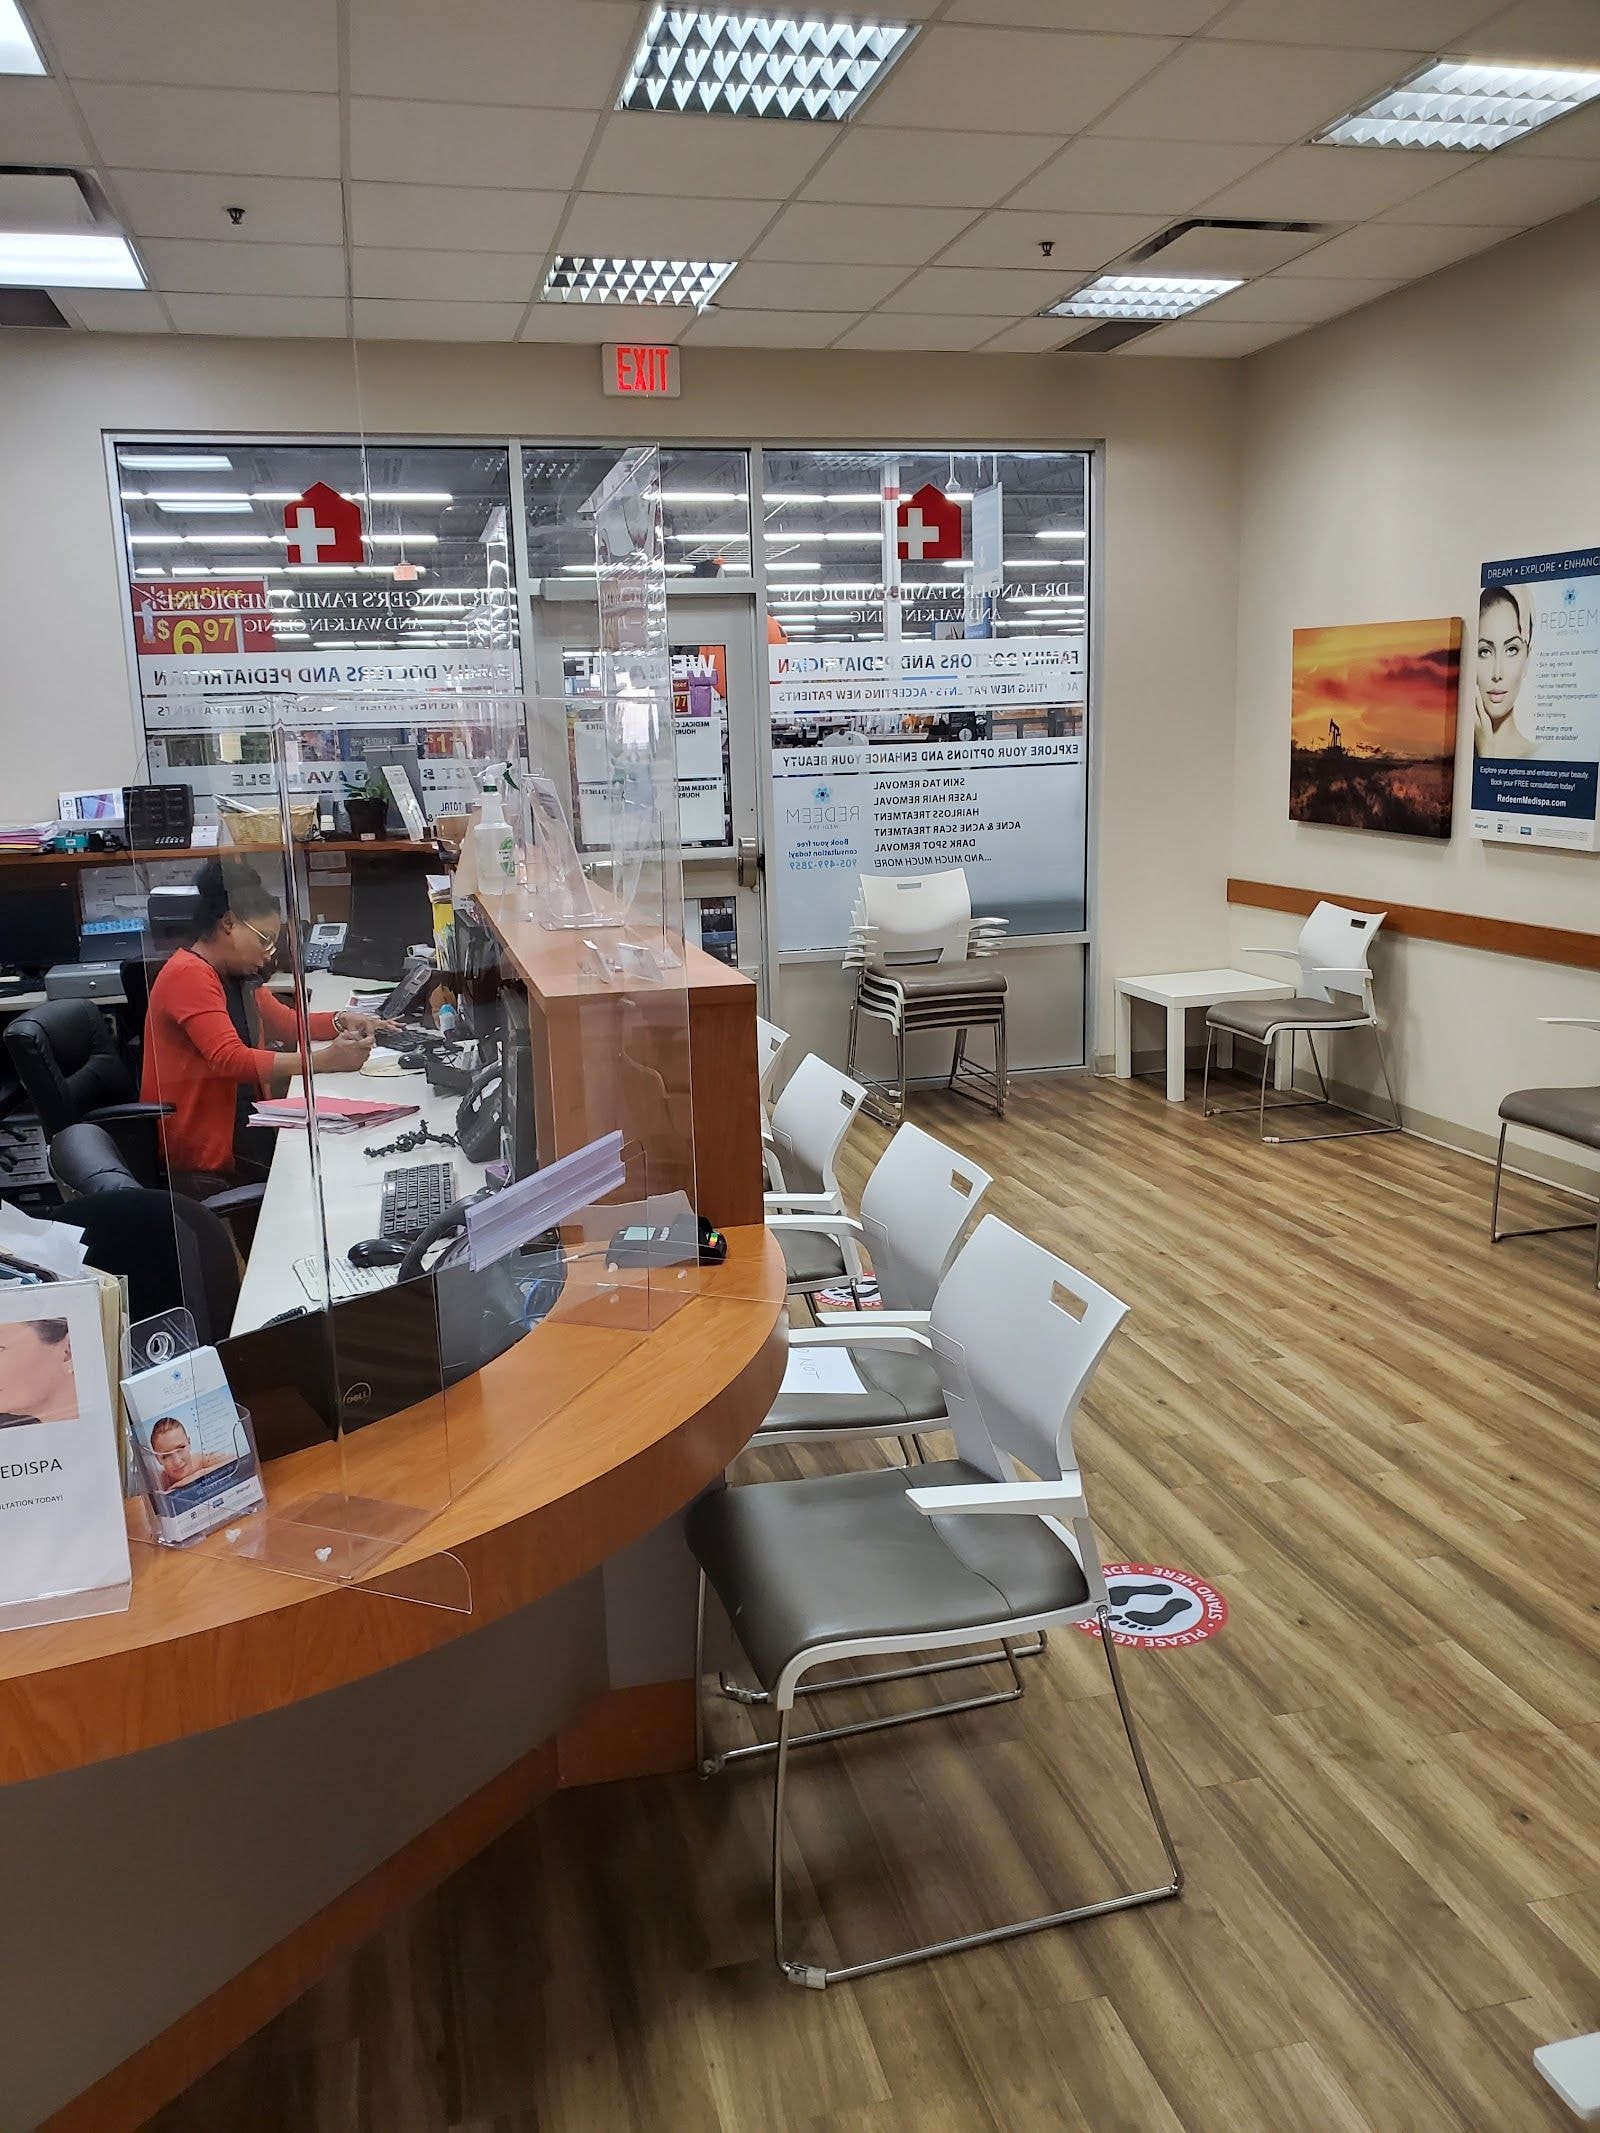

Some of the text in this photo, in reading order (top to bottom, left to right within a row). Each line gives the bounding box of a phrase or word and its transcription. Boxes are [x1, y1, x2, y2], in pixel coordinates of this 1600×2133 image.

[617, 347, 669, 392] EXIT
[1487, 556, 1600, 579] DREAM EXPLORE ENHANC
[1540, 608, 1599, 630] REDEEM
[1546, 726, 1560, 734] many
[1480, 766, 1498, 776] Explore
[1497, 768, 1509, 777] your
[1508, 768, 1526, 777] options
[1558, 772, 1570, 780] your
[1490, 778, 1576, 792] Book your FREE consultation today!
[1497, 794, 1567, 808] RedeemMedispa.com
[0, 1458, 63, 1479] EDISPA
[35, 1494, 63, 1504] TODAY!
[1151, 1566, 1224, 1621] STAND HERE
[1144, 1628, 1209, 1647] PLEASE
